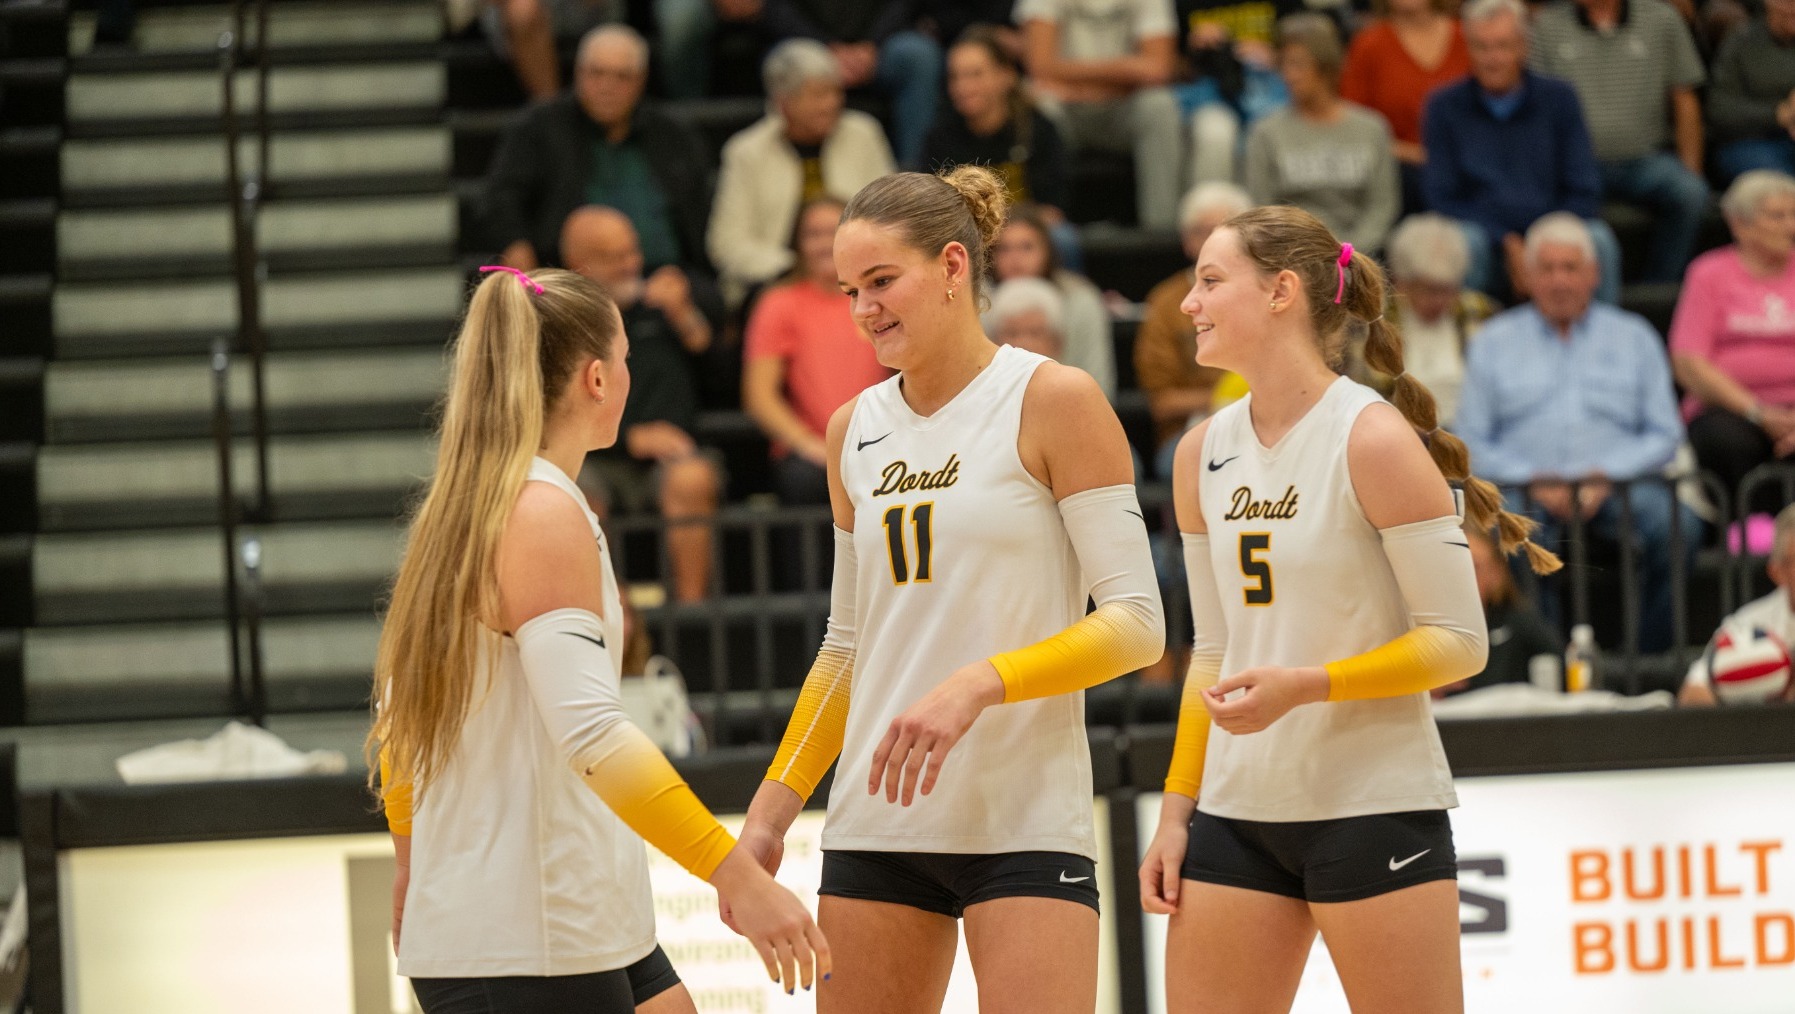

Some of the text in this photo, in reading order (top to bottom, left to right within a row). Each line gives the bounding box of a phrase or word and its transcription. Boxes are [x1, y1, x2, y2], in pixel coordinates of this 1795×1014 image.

[872, 453, 960, 497] Dordt
[1224, 485, 1299, 521] Dordt
[882, 501, 934, 585] 11
[1238, 531, 1275, 607] 5
[1569, 839, 1783, 904] BUILT
